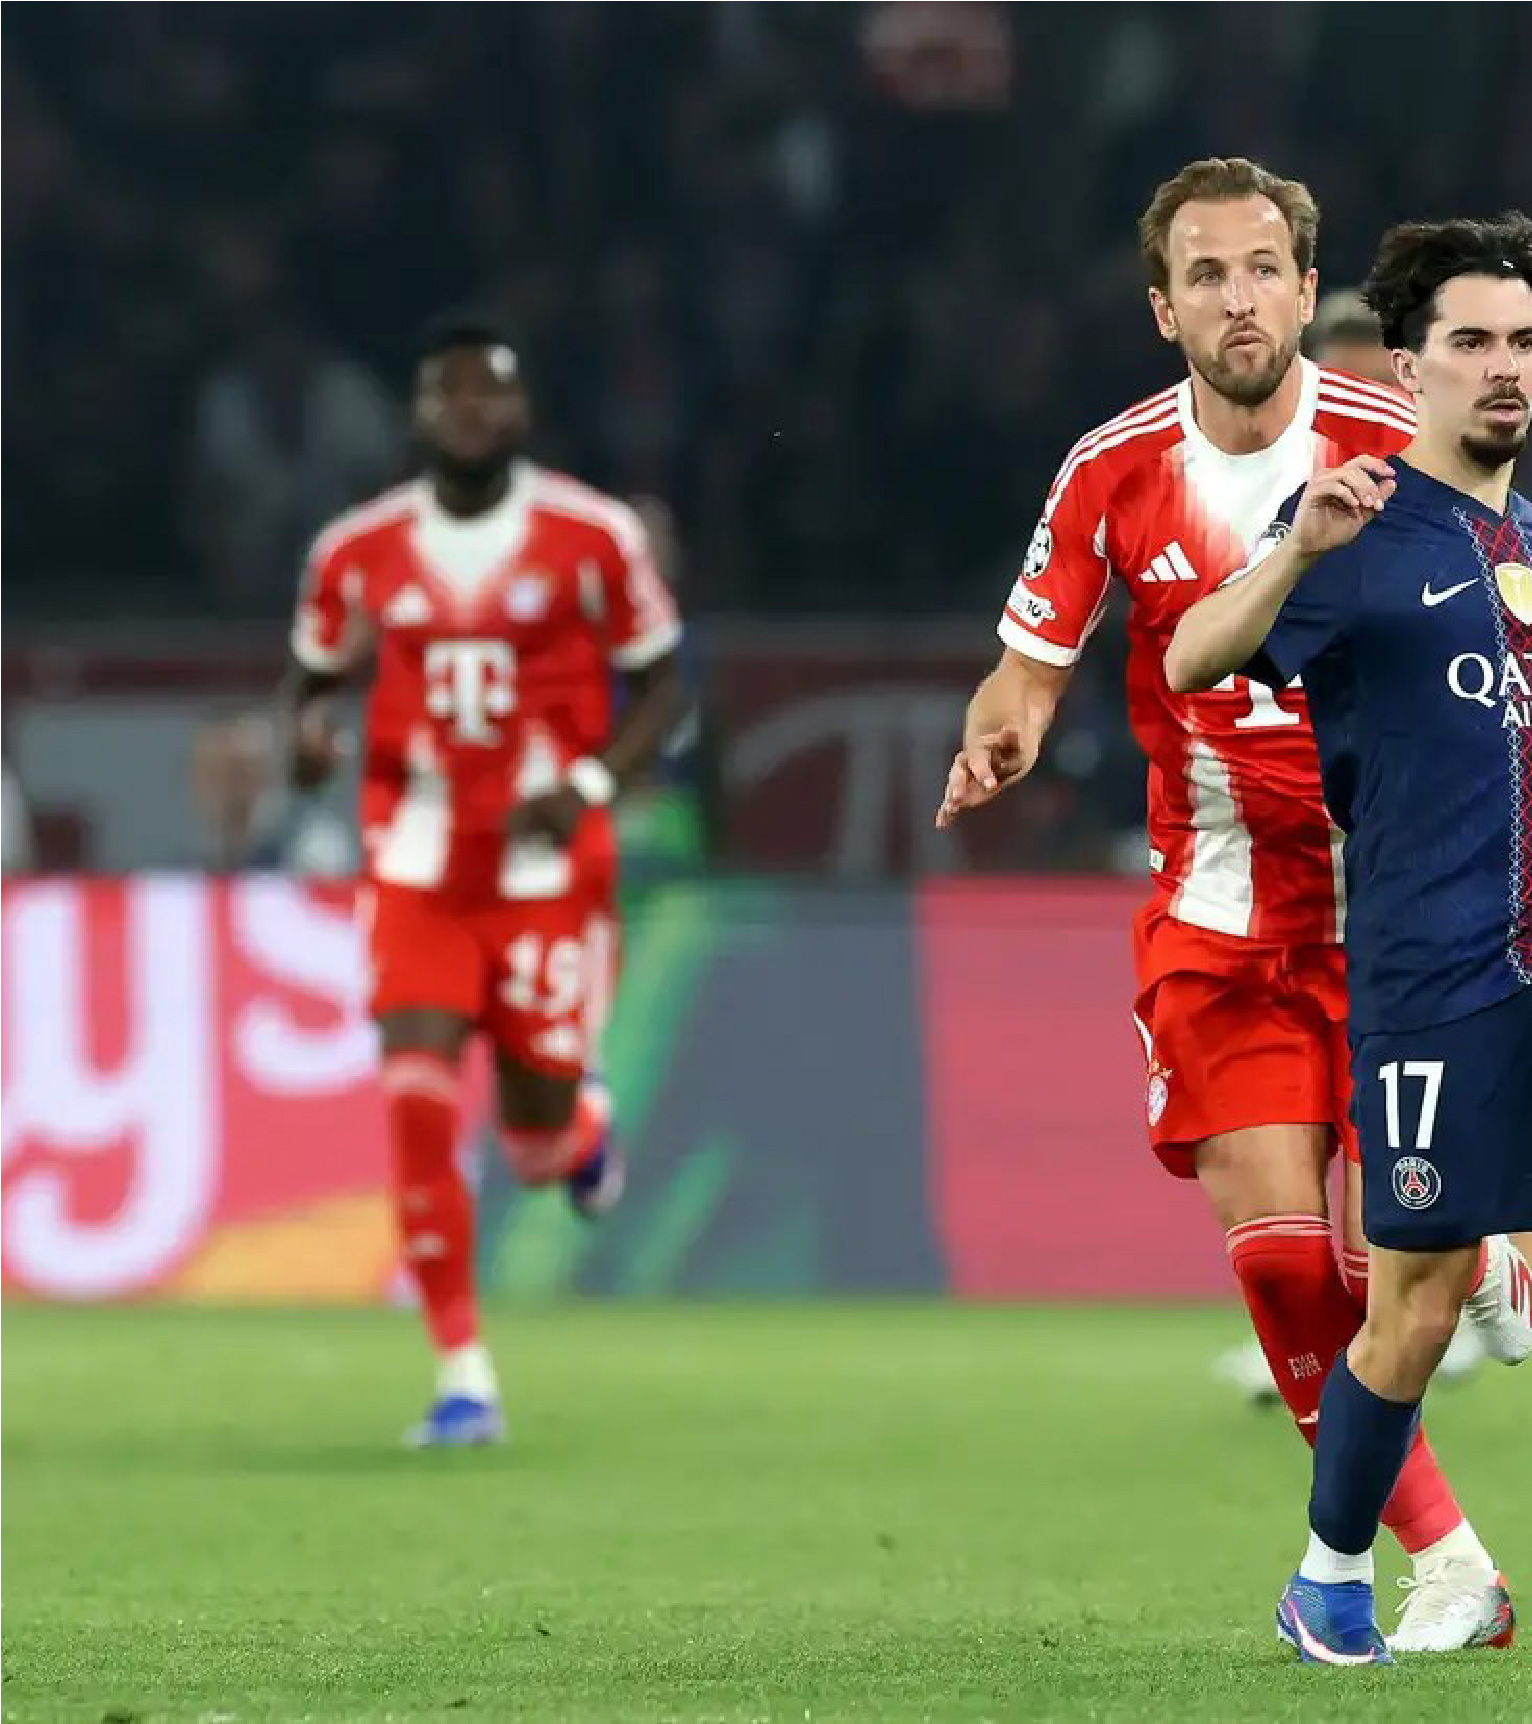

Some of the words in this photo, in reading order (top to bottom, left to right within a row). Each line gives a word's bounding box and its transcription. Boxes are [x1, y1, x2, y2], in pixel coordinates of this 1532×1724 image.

[423, 640, 518, 745] T
[500, 935, 584, 1013] 19
[1377, 1060, 1445, 1150] 17
